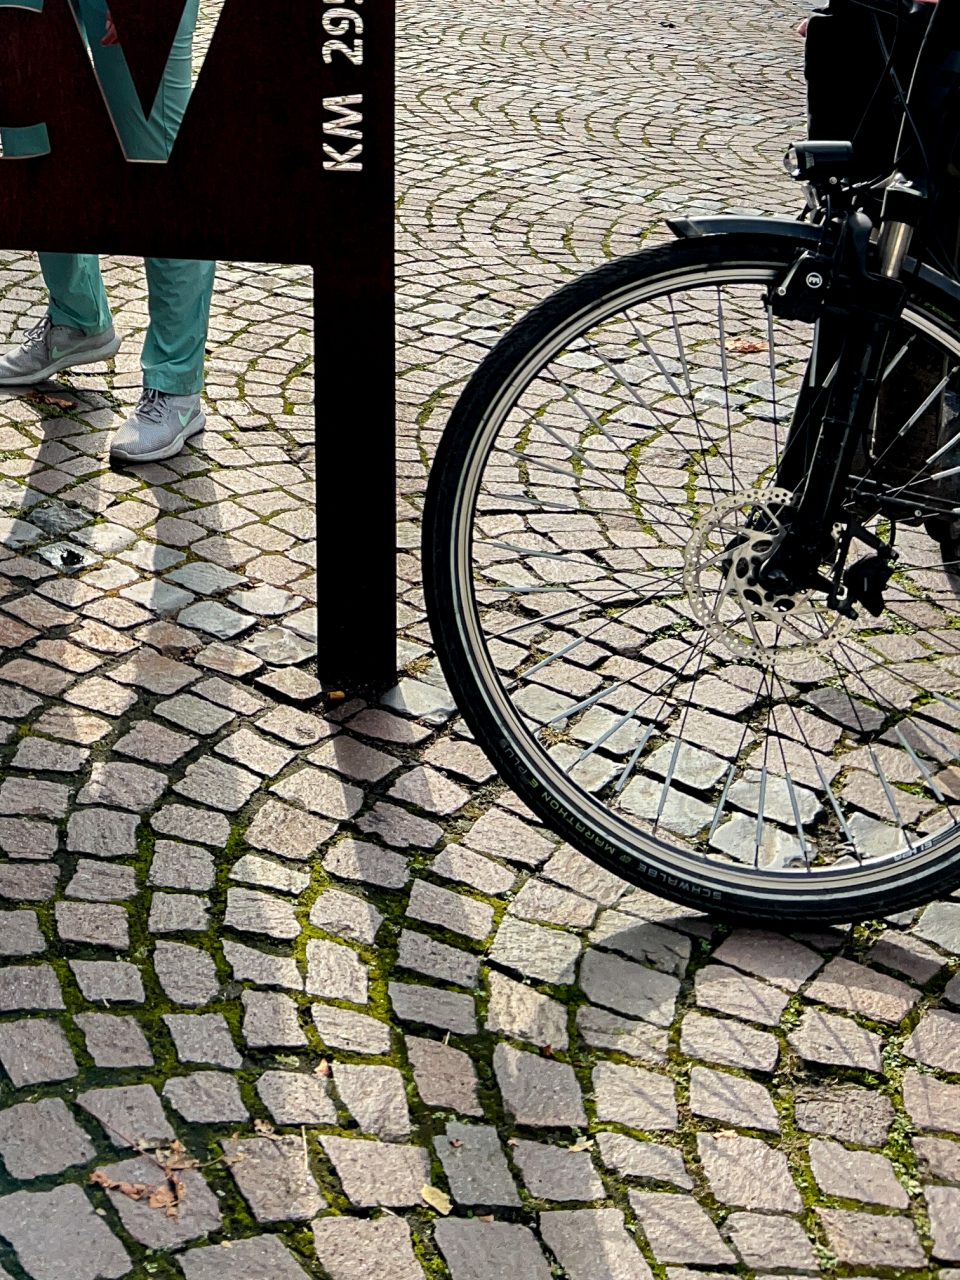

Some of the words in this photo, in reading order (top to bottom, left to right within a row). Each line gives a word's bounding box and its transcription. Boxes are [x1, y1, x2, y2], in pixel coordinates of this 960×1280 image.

[322, 93, 363, 171] KM
[541, 791, 616, 855] MARATHON
[637, 864, 723, 901] SCHWALBE
